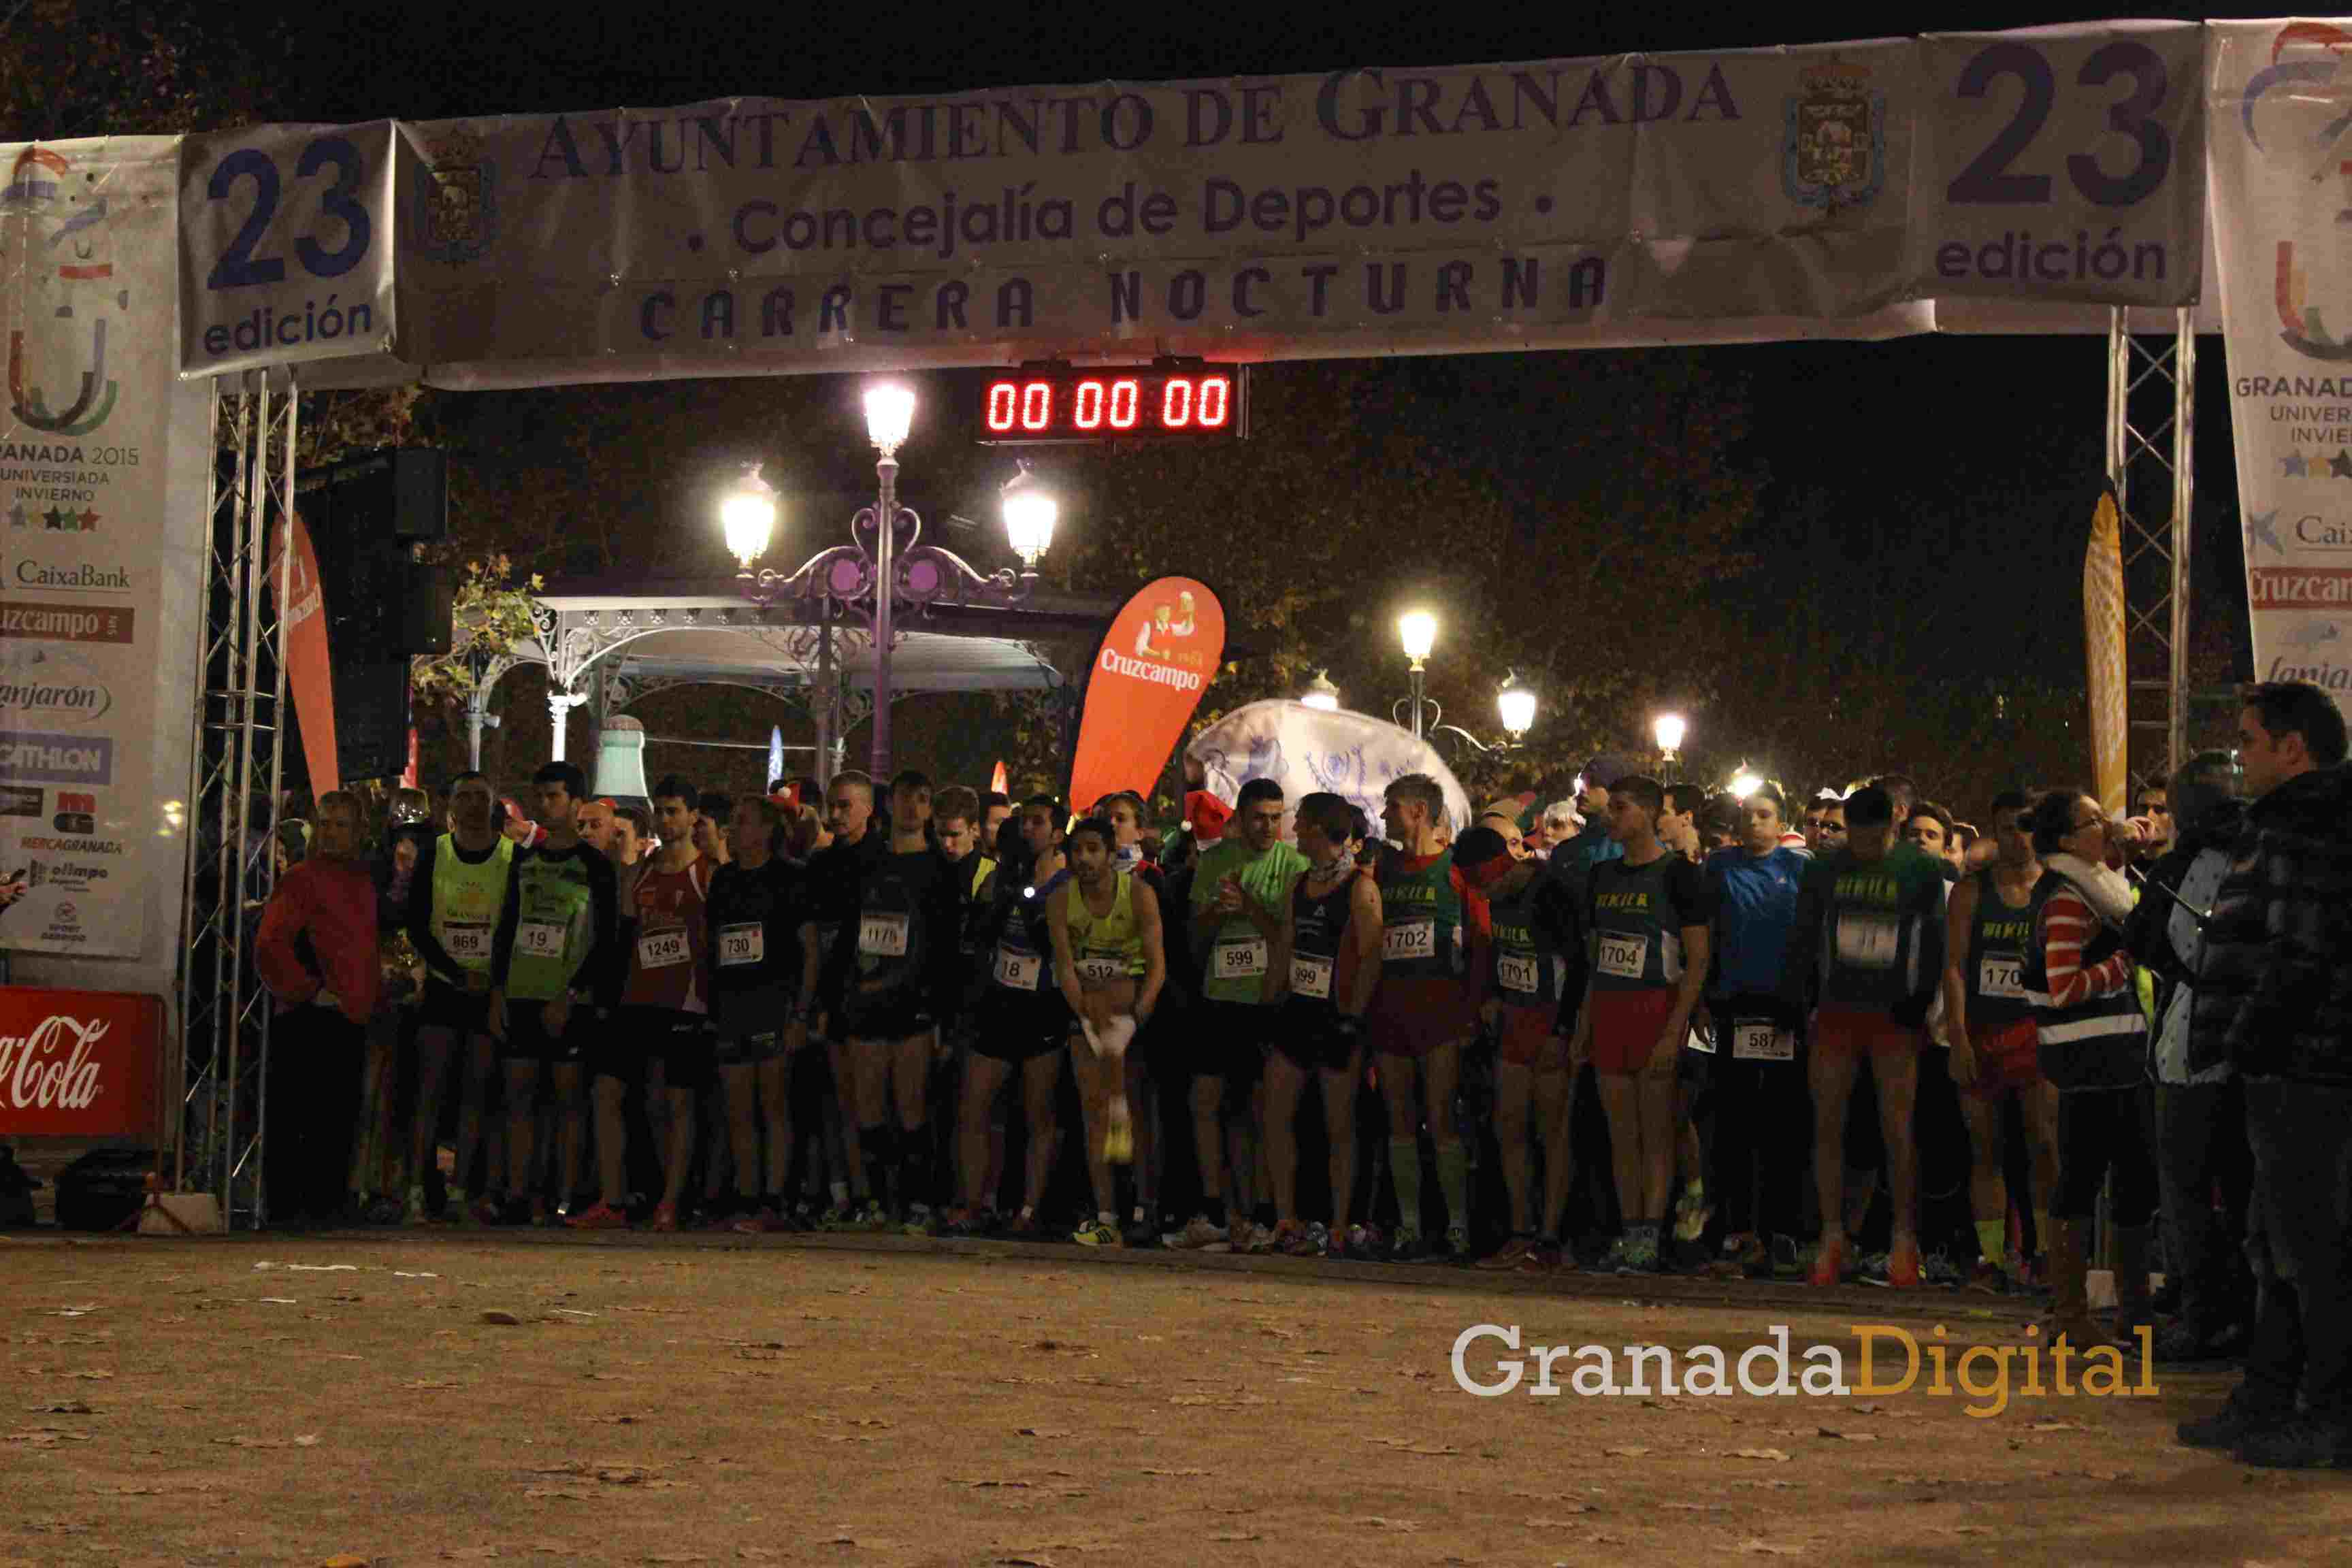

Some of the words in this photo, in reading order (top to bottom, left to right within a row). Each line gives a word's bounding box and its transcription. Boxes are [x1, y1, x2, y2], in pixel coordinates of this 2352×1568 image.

[528, 93, 1155, 179] AYUNTAMIENTO
[1181, 86, 1285, 148] DE
[1316, 61, 1744, 141] GRANADA
[1946, 42, 2171, 206] 23
[206, 134, 372, 291] 23
[731, 181, 1074, 258] Concejalía
[1097, 182, 1179, 236] de
[1204, 169, 1501, 242] Deportes
[1933, 227, 2167, 281] edición
[639, 277, 1034, 340] CARRERA
[1107, 256, 1606, 323] NOCTURNA
[204, 293, 372, 356] edición
[987, 381, 1051, 430] 00
[1075, 379, 1138, 429] 00
[1162, 377, 1228, 427] 00
[2291, 427, 2352, 444] INVIE
[0, 443, 84, 463] ANADA
[92, 446, 140, 466] 2015
[1, 467, 110, 485] UNIVERSIADA
[16, 487, 95, 502] INVIERNO
[16, 559, 131, 588] CaixaBank
[1100, 647, 1201, 692] Cruzcampo
[529, 931, 546, 947] 19
[647, 939, 680, 959] 1249
[728, 937, 750, 953] 730
[1386, 931, 1427, 948] 1702
[1226, 951, 1254, 966] 599
[1601, 946, 1640, 966] 1704
[1088, 965, 1113, 979] 512
[1986, 966, 2027, 985] 170
[1748, 1032, 1776, 1048] 587
